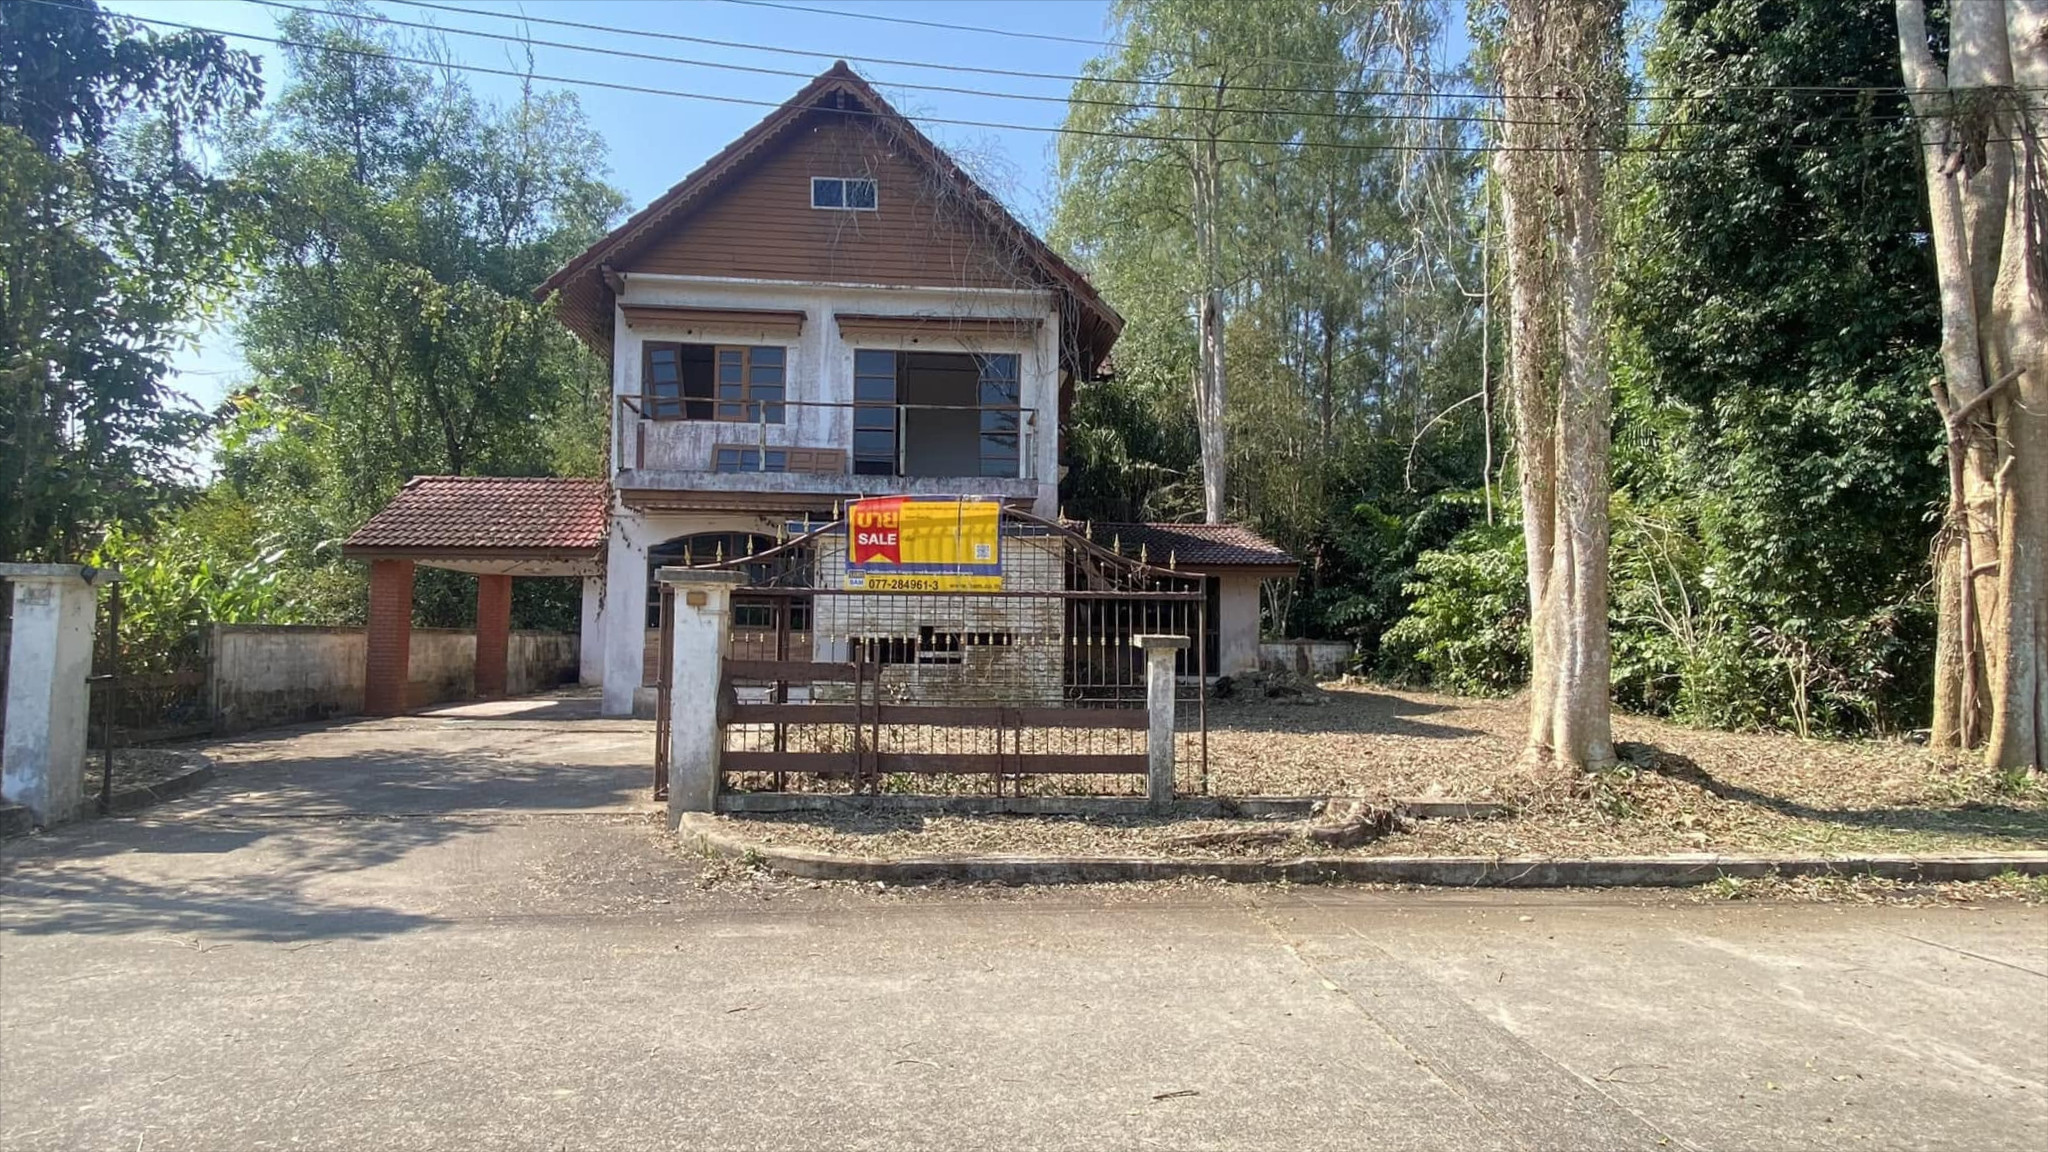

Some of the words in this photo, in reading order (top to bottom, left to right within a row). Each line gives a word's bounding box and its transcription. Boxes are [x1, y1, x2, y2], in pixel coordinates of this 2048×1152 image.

[857, 511, 898, 528] ขาย
[858, 533, 897, 545] SALE
[868, 579, 939, 590] 077-284961-3
